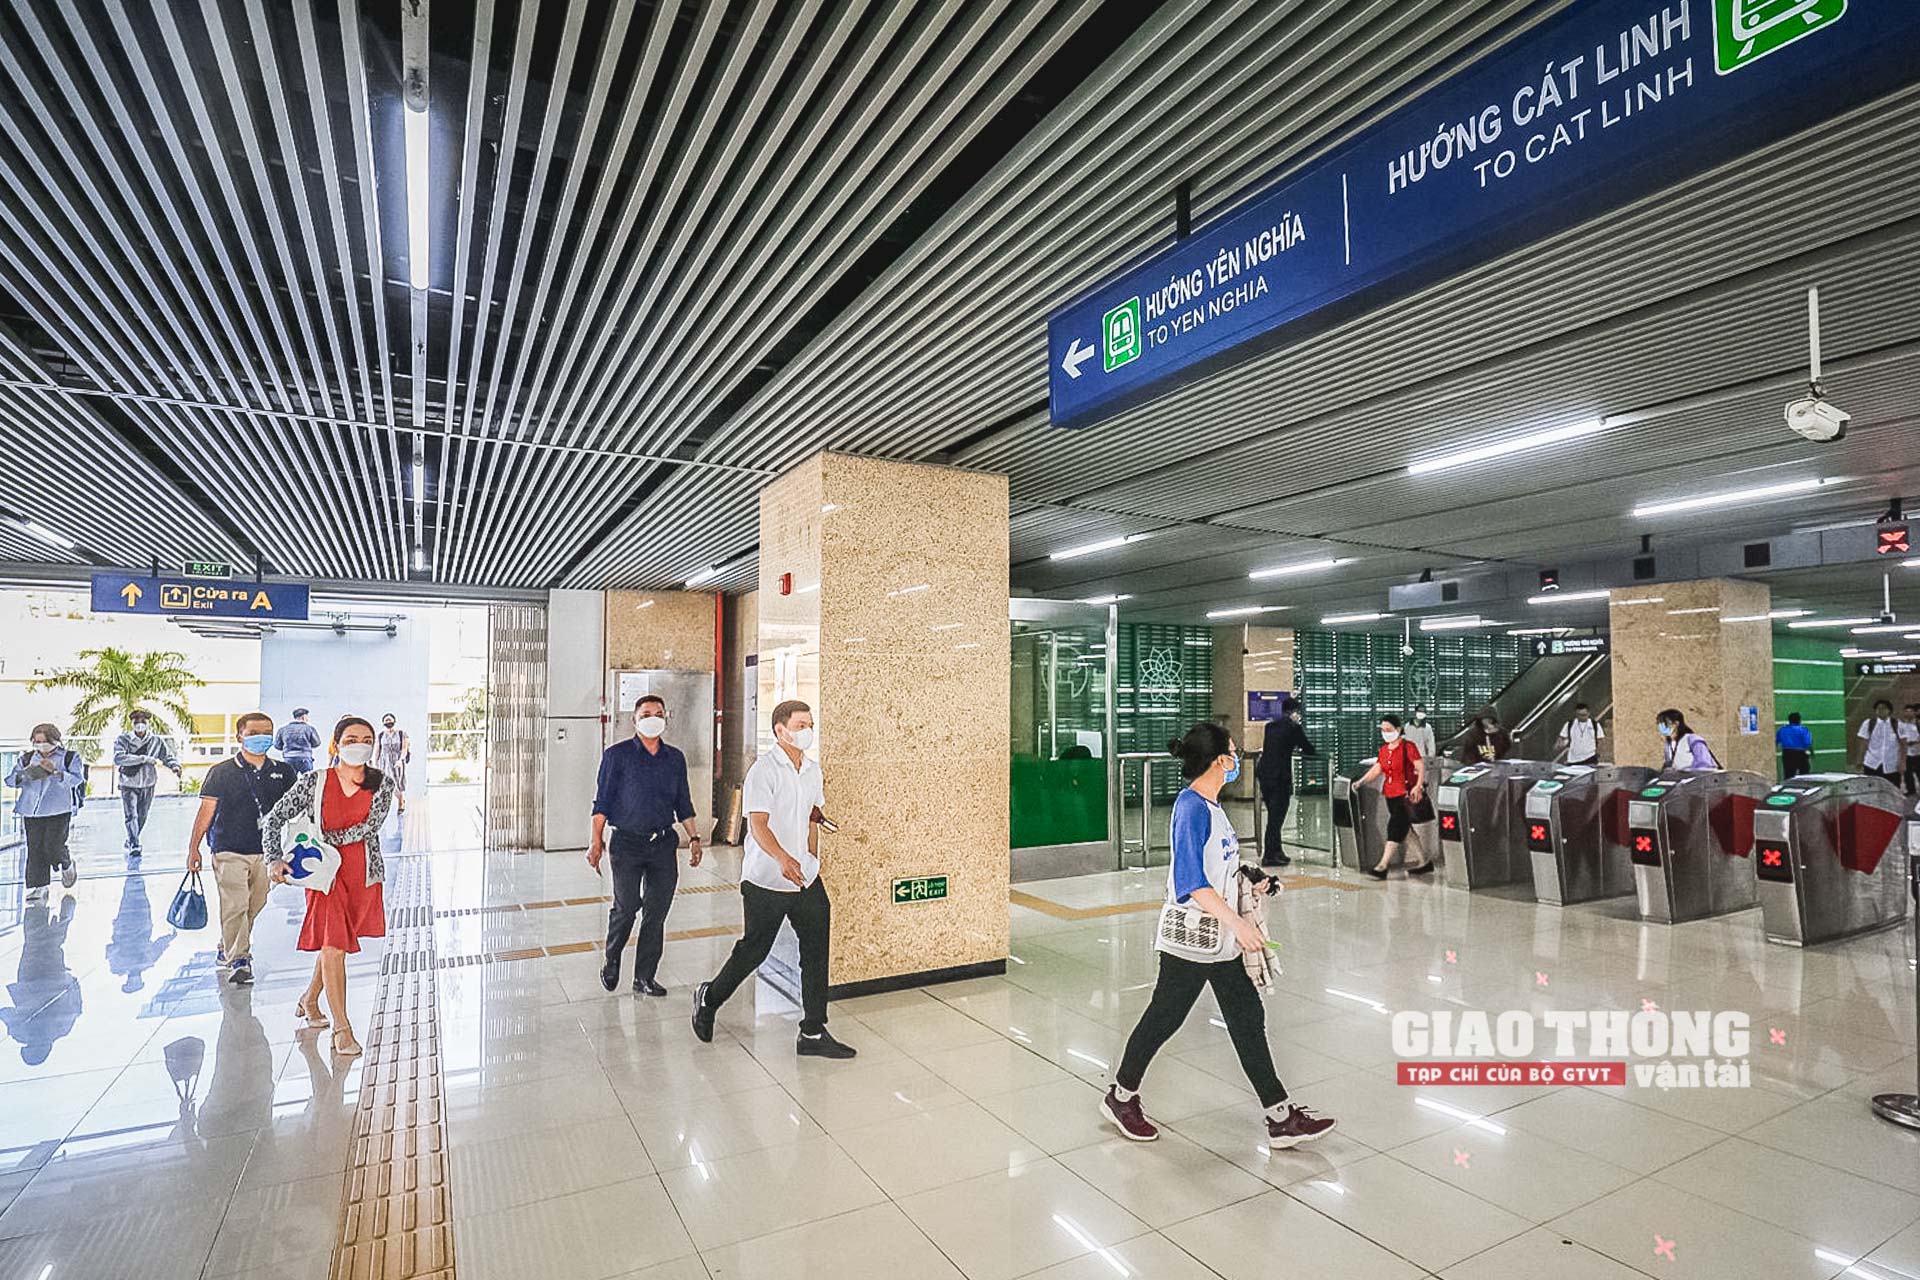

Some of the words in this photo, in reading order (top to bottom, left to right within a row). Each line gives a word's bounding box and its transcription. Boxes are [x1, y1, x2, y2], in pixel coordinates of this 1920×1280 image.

[1388, 104, 1502, 195] HƯỚNG
[1512, 55, 1584, 126] CÁT
[1596, 0, 1690, 85] LINH
[1473, 150, 1516, 188] TO
[1524, 108, 1592, 163] CAT
[1601, 57, 1693, 129] LINH
[1146, 268, 1203, 322] HƯỚNG
[1205, 248, 1240, 289] YÊN
[1245, 210, 1306, 270] NGHĨA
[1147, 325, 1168, 348] TO
[1170, 305, 1205, 337] YEN
[1208, 275, 1269, 320] NGHIA
[193, 563, 223, 572] EXIT
[192, 601, 214, 609] Exit
[193, 587, 229, 600] Cửa
[231, 592, 248, 601] ra
[249, 591, 273, 611] A
[928, 888, 945, 897] EXIT
